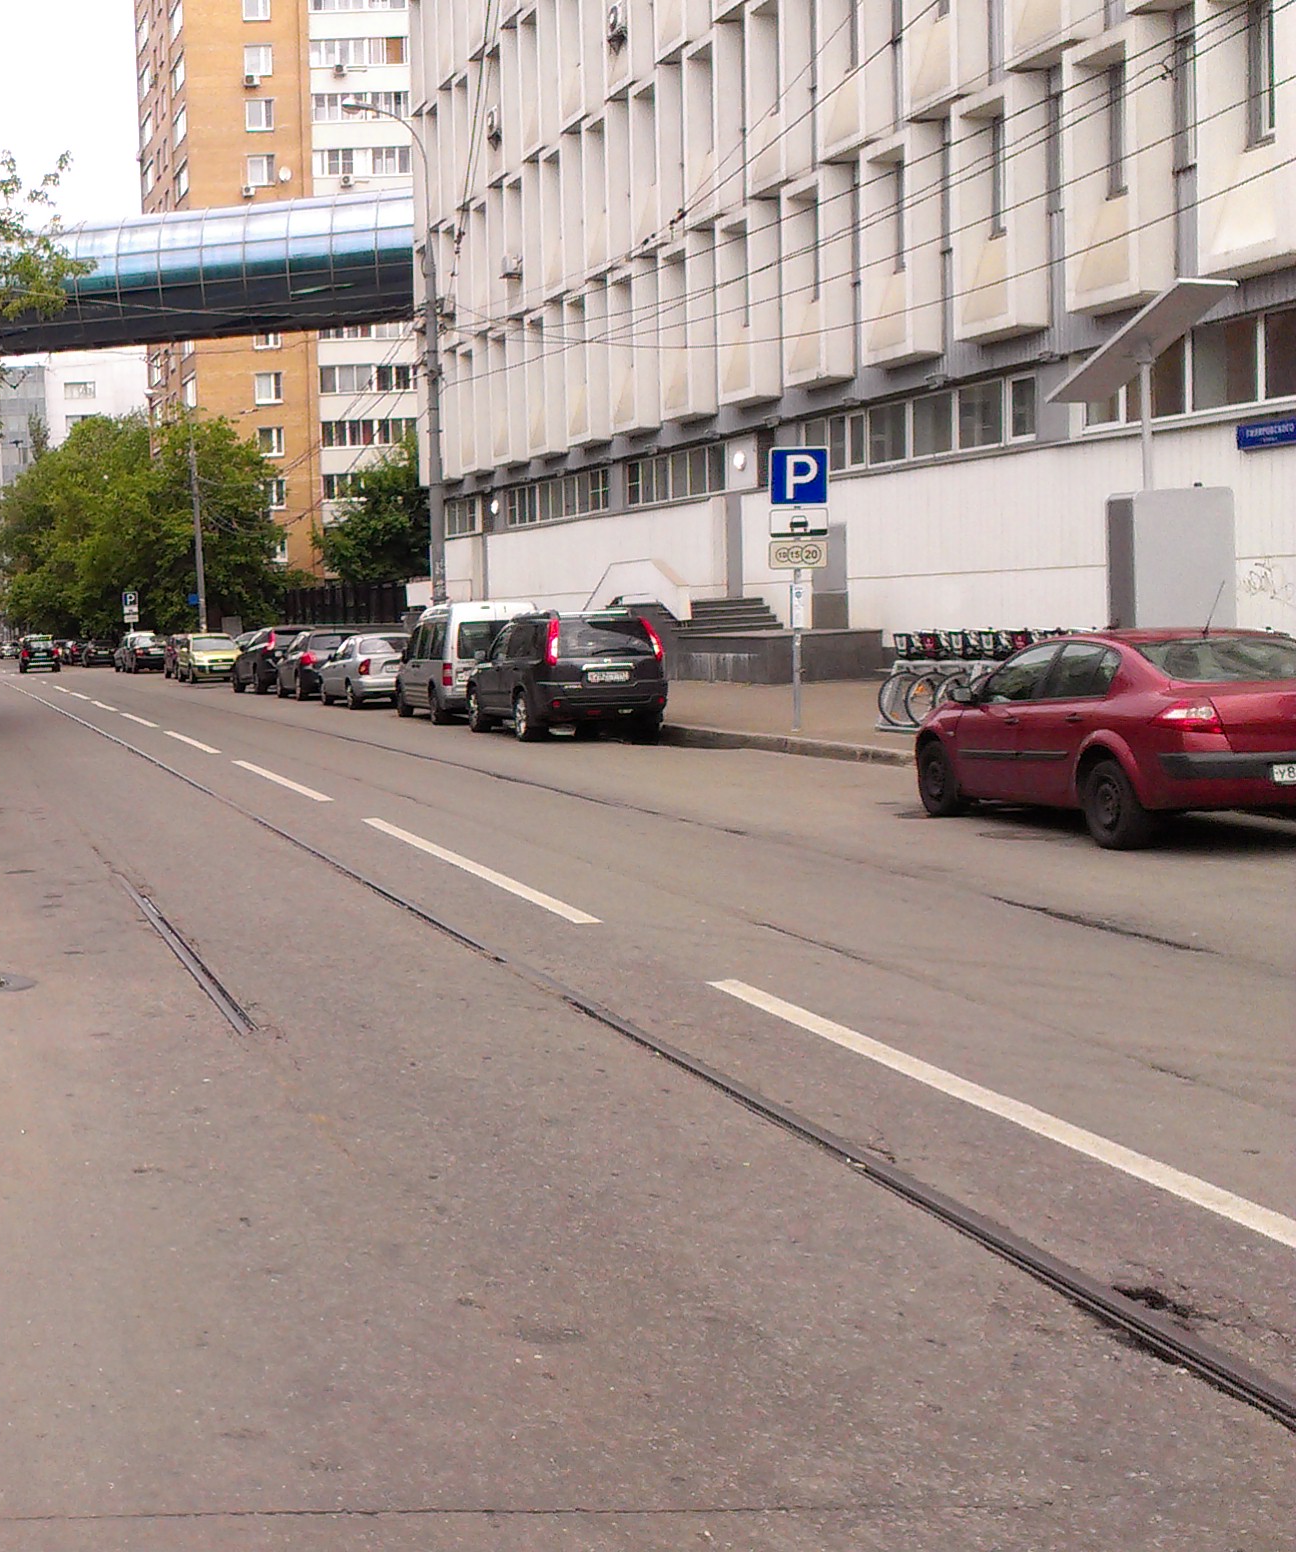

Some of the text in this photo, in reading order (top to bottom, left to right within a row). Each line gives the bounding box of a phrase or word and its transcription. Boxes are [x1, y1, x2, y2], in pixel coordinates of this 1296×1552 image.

[786, 454, 818, 500] P
[790, 550, 800, 559] 15
[804, 549, 818, 559] 20
[126, 593, 135, 606] P
